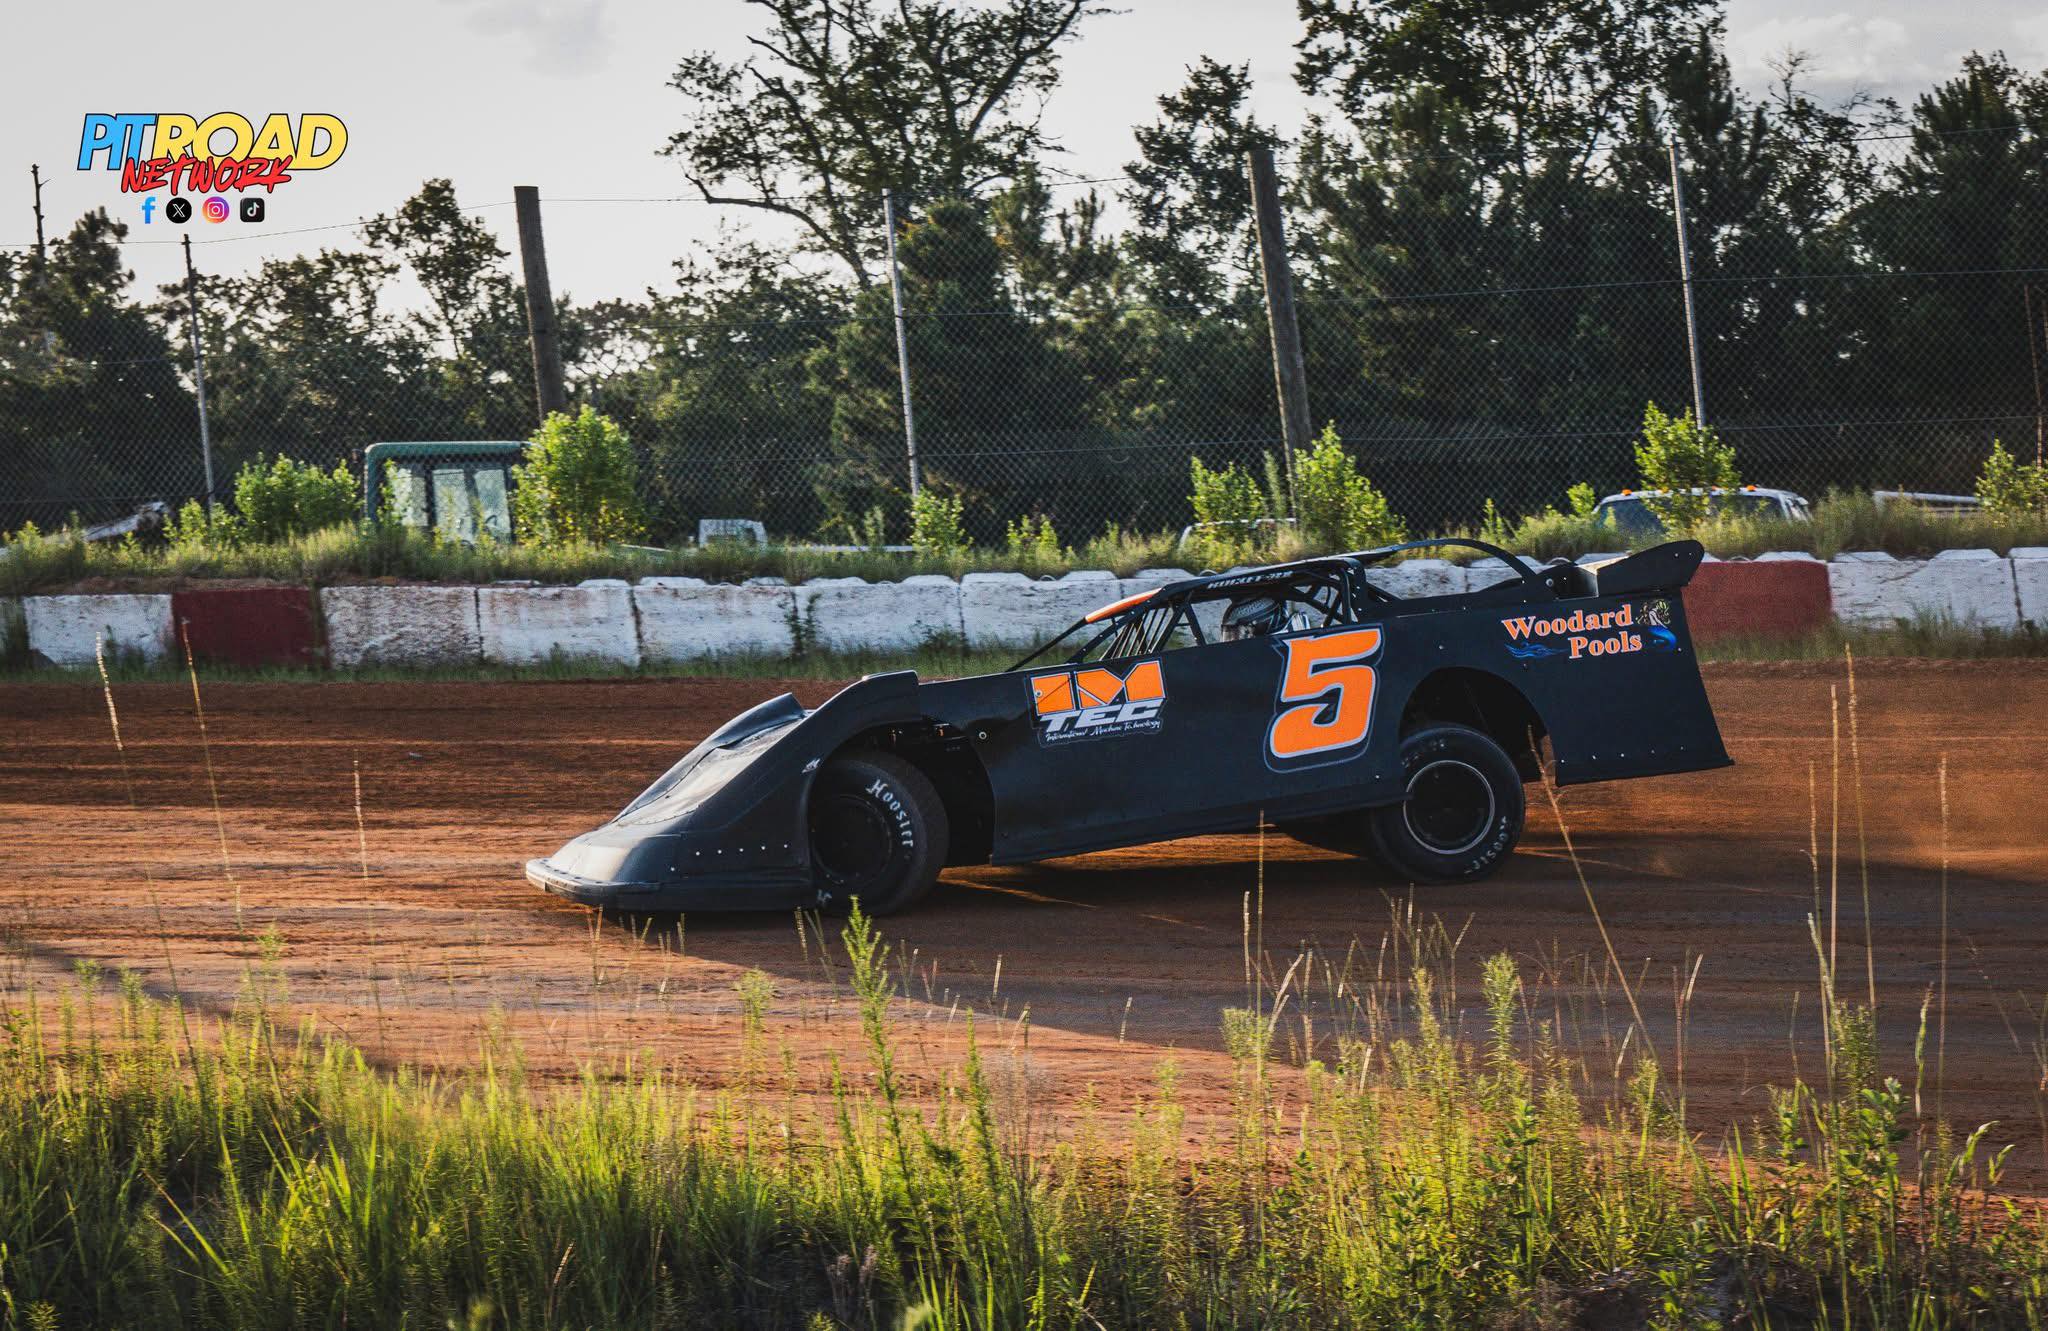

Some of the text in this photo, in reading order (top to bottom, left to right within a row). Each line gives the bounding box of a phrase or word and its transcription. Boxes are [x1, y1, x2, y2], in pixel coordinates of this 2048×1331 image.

[1501, 604, 1633, 640] Woodard
[1568, 631, 1642, 659] Pools
[1269, 628, 1382, 758] 5
[1040, 700, 1163, 733] TEC
[1045, 729, 1087, 742] International
[1124, 719, 1161, 731] Technology
[865, 779, 914, 847] Hoosier
